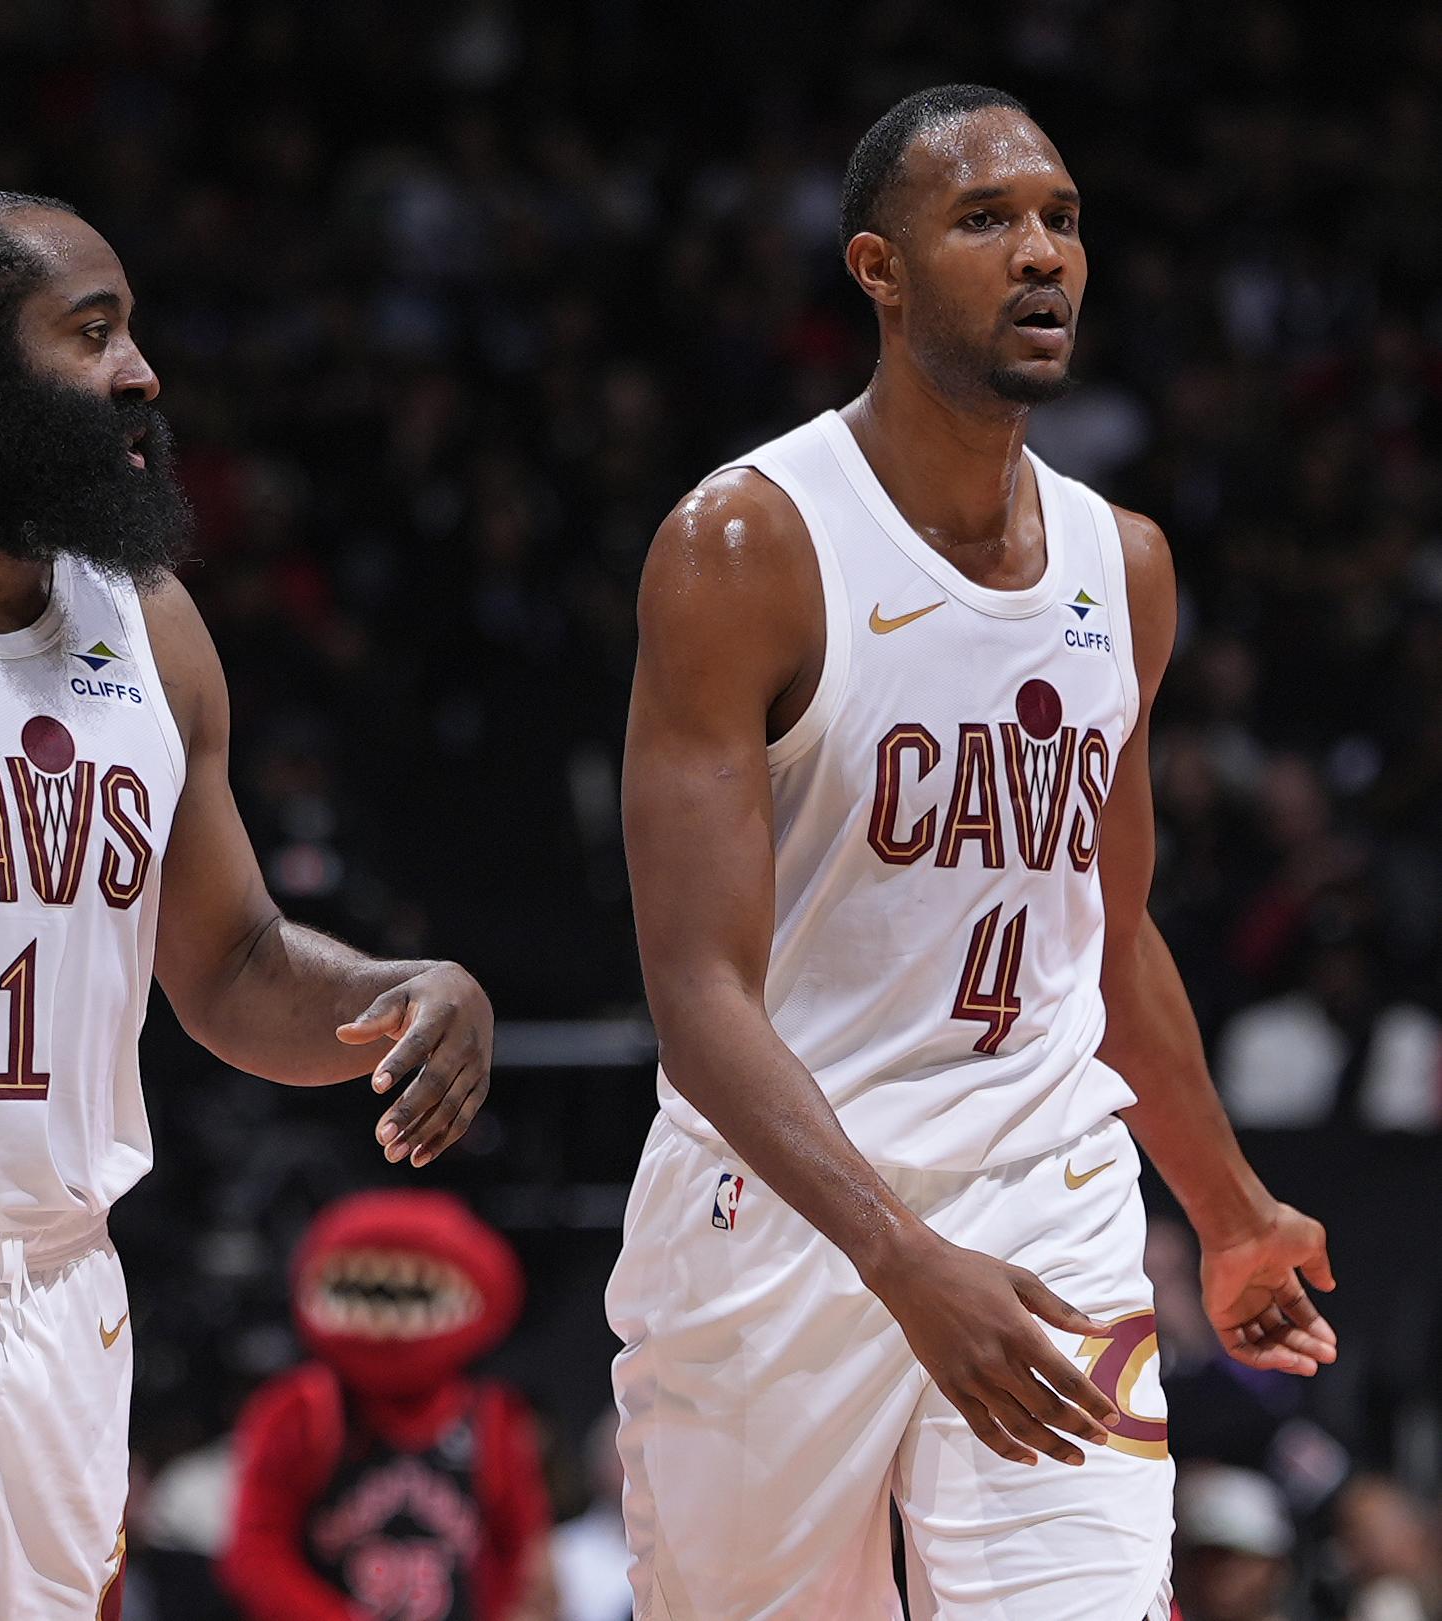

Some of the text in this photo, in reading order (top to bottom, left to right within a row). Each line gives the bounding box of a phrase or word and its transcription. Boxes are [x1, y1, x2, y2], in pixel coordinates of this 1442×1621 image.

[1065, 629, 1110, 653] CLIFFS
[70, 677, 143, 705] CLIFFS
[867, 722, 1110, 873] CAVS
[950, 901, 1029, 1056] 4
